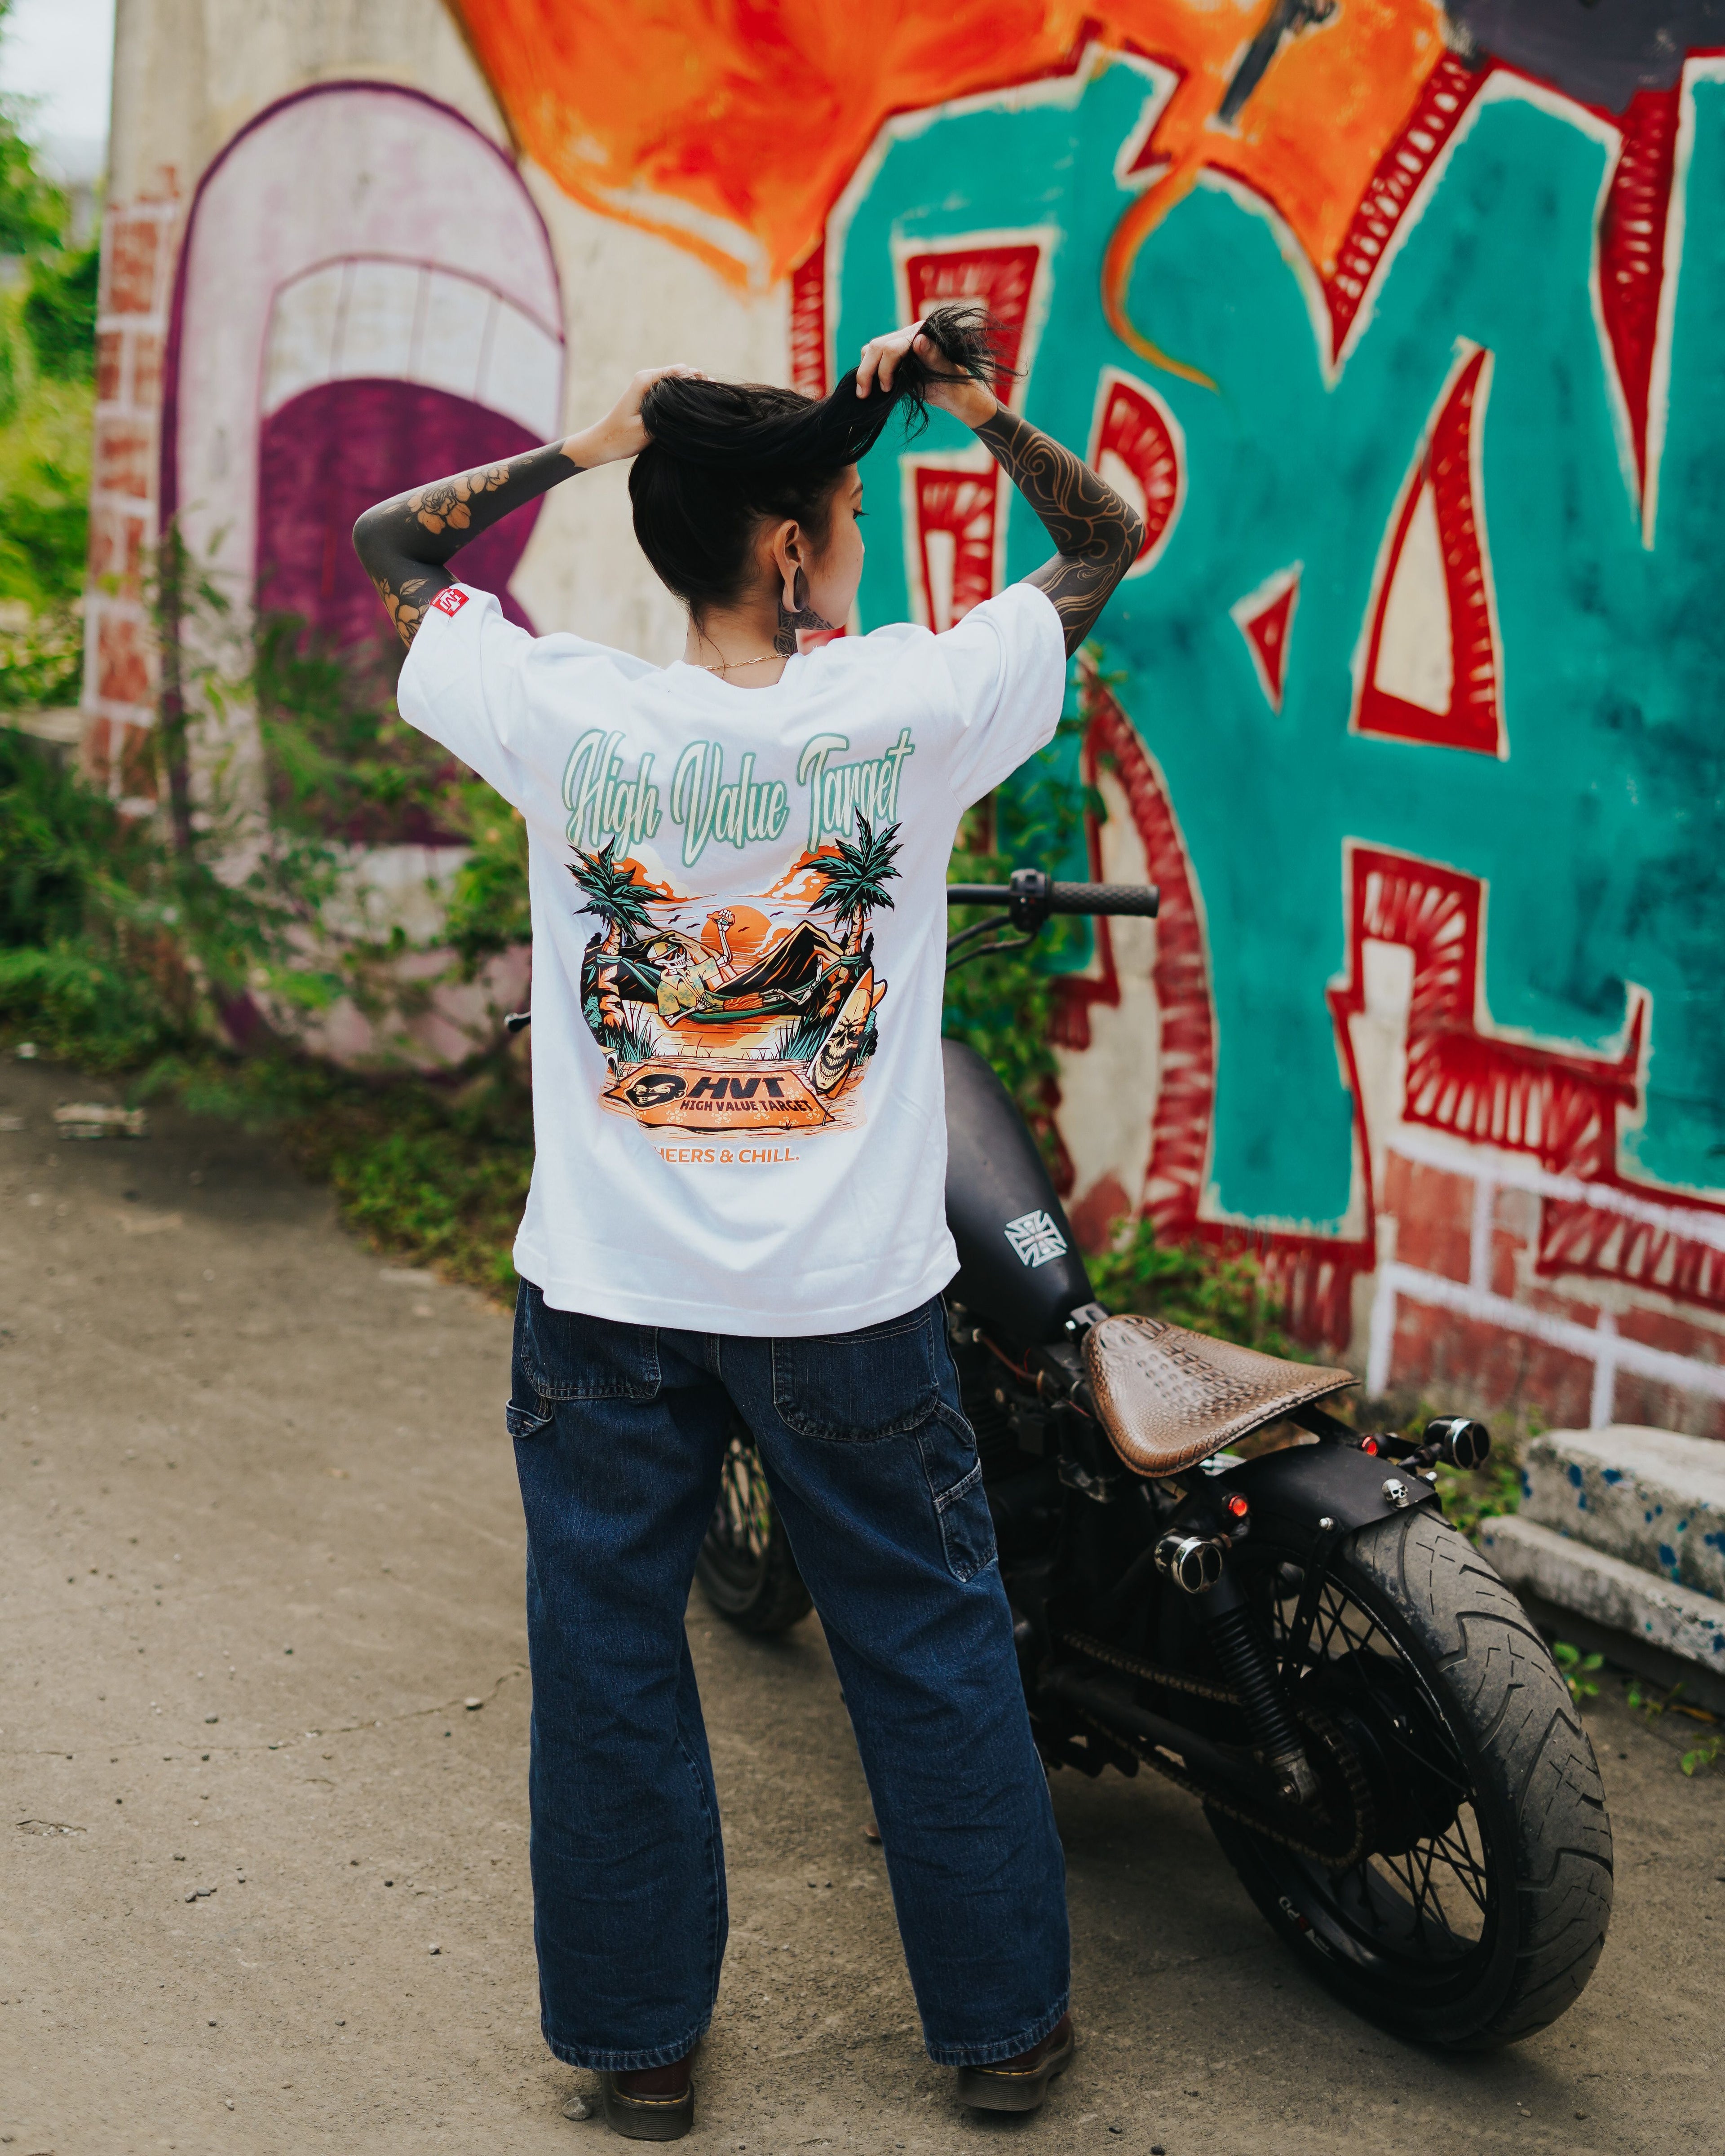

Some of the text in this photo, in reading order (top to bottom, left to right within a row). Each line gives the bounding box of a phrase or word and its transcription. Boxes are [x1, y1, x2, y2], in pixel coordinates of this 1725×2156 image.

[562, 727, 915, 868] High Value Target
[687, 1077, 785, 1099] HVT
[680, 1100, 813, 1111] HIGH VALUE TARGET
[720, 1149, 734, 1163] &
[739, 1148, 799, 1163] CHILL.
